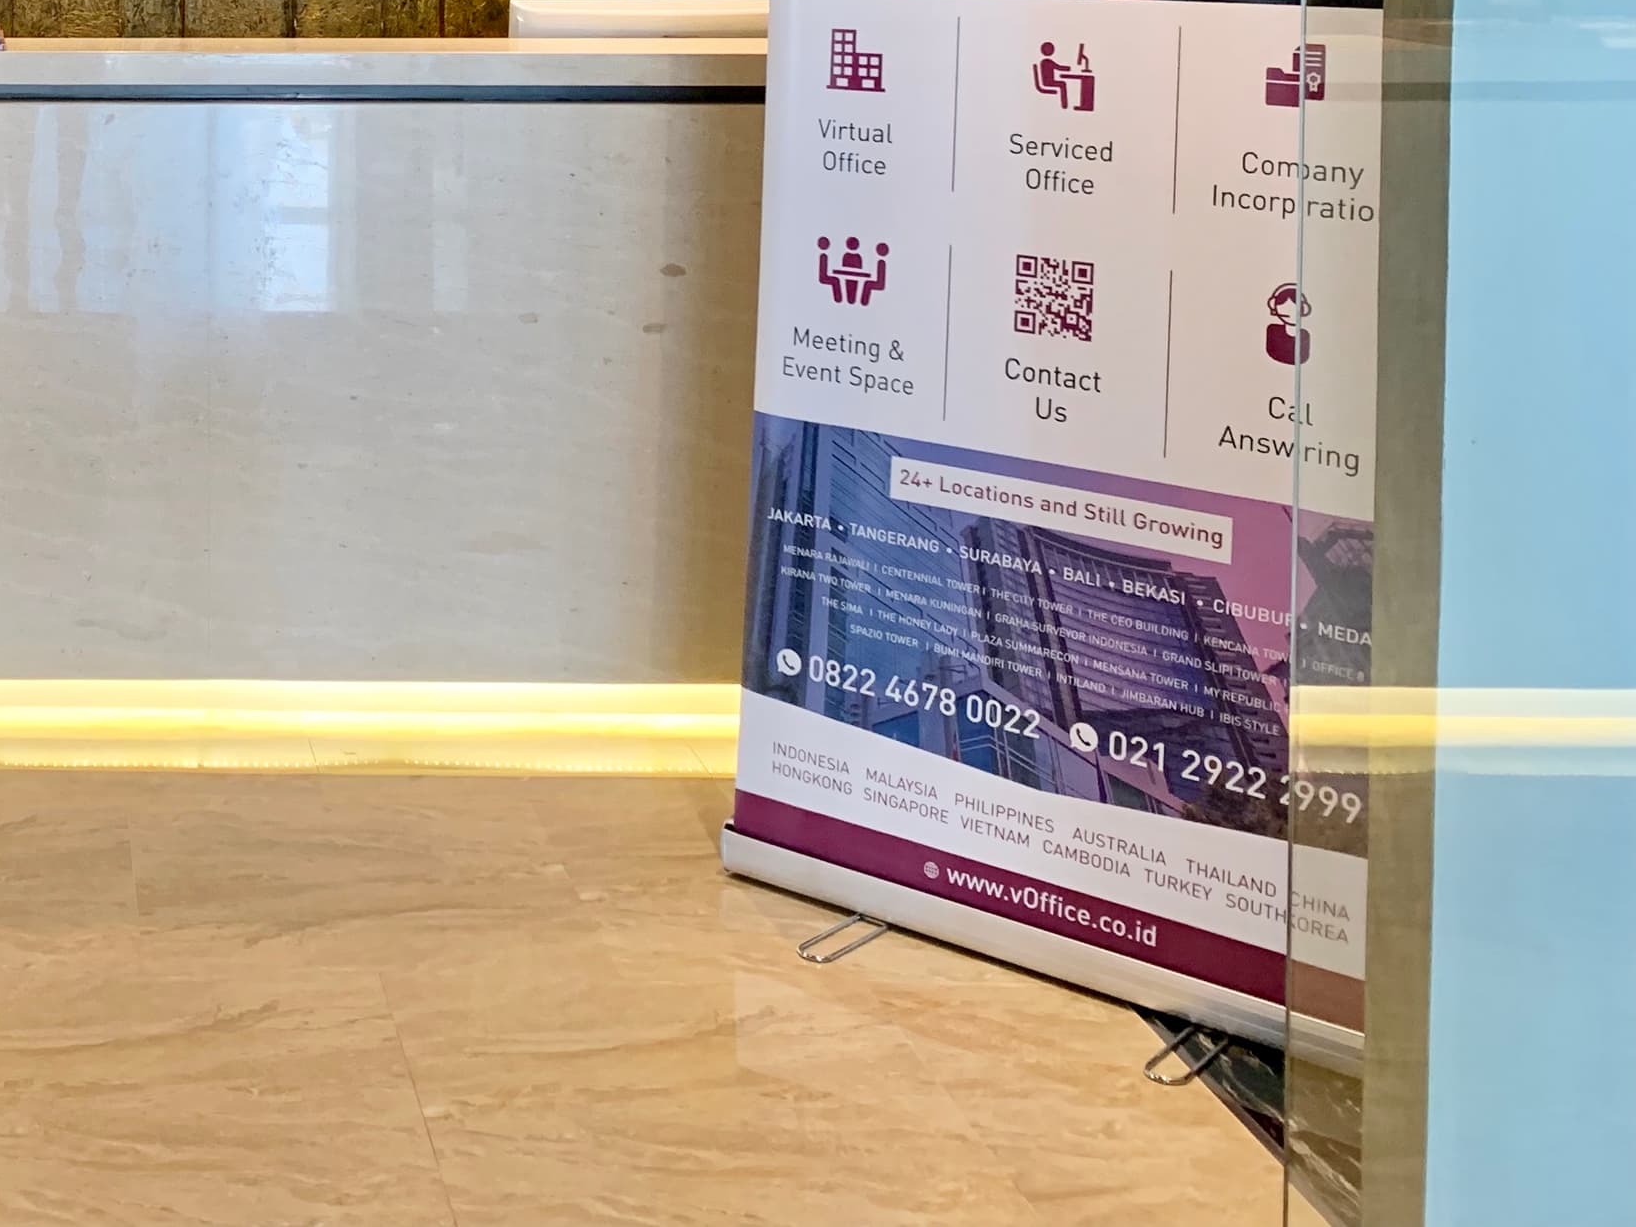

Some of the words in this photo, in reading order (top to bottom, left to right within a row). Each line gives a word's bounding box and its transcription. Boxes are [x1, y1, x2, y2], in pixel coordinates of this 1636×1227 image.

[818, 119, 892, 144] Virtual
[823, 150, 886, 175] Office
[1009, 134, 1113, 162] Serviced
[1025, 168, 1095, 195] Office
[1213, 184, 1374, 222] Incorpratio
[783, 356, 841, 384] Event
[849, 366, 914, 396] Space
[793, 326, 880, 363] Meeting
[888, 339, 904, 361] &
[1005, 357, 1102, 393] Contact
[1035, 396, 1067, 423] Us
[1218, 425, 1359, 477] Answring
[899, 469, 933, 488] 24+
[939, 476, 1034, 509] Locations
[1041, 498, 1077, 517] and
[1084, 503, 1125, 526] Still
[1133, 513, 1224, 549] Growing
[767, 508, 831, 531] JAKARTA
[849, 523, 939, 553] TANGERANG
[959, 545, 1042, 575] SURABAYA
[1064, 567, 1101, 587] BALI
[1122, 579, 1186, 605] BEKASI
[1318, 621, 1372, 646] MEDA
[783, 544, 823, 560] MENARA
[881, 565, 943, 586] CENTENNIAL
[947, 579, 980, 595] TOWER
[991, 588, 1011, 601] THE
[1013, 592, 1035, 608] CITY
[1038, 597, 1073, 615] TOWER
[1088, 610, 1109, 623] THE
[1111, 614, 1133, 628] CEO
[1135, 619, 1189, 641] BUILDING
[1204, 636, 1259, 656] KENCANA
[1262, 648, 1292, 665] TOW
[781, 566, 816, 582] KIRANA
[818, 573, 838, 586] TWO
[840, 577, 871, 594] TOWER
[885, 588, 927, 606] MENARA
[930, 598, 982, 618] KUNINGAN
[995, 613, 1030, 630] GRAHA
[1031, 622, 1086, 643] SURVEYOR
[1088, 634, 1147, 656] INDONESIA
[1162, 651, 1202, 670] GRAND
[1204, 661, 1234, 677] SLIPI
[1236, 669, 1276, 686] TOWER
[822, 597, 839, 609] THE
[840, 600, 863, 615] SIMA
[878, 610, 896, 623] THE
[898, 614, 932, 631] HONEY
[934, 621, 958, 636] LADY
[971, 631, 1003, 648] PLAZA
[1005, 639, 1079, 664] SUMMARECON
[1093, 660, 1146, 680] MENSANA
[1149, 673, 1188, 691] TOWER
[1204, 685, 1221, 699] MY
[1222, 690, 1281, 713] REPUBLIC
[809, 655, 876, 697] 0822
[885, 674, 956, 717] 4678
[966, 694, 1041, 739] 0022
[850, 624, 882, 640] SPAZIO
[885, 632, 918, 648] TOWER
[934, 644, 959, 659] BUMI
[961, 652, 1004, 669] MANDIRI
[1007, 661, 1042, 678] TOWER
[1056, 672, 1106, 693] INTILAND
[1121, 689, 1177, 710] JIMBARAN
[1180, 703, 1204, 717] HUB
[1220, 713, 1242, 727] IBIS
[1244, 719, 1280, 736] STYLE
[1109, 730, 1165, 772] 021
[1181, 749, 1266, 799] 2922
[771, 760, 853, 796] HONGKONG
[863, 787, 949, 824] SINGAPORE
[960, 814, 1030, 848] VIETNAM
[1042, 840, 1131, 878] CAMBODIA
[1144, 868, 1213, 901] TURKEY
[1226, 893, 1286, 921] SOUTH
[772, 742, 850, 775] INDONESIA
[865, 768, 938, 800] MALAYSIA
[955, 792, 1055, 833] PHILIPPINES
[1072, 828, 1166, 866] AUSTRALIA
[1186, 858, 1277, 898] THAILAND
[1291, 891, 1350, 922] CHINA
[945, 865, 1158, 948] www.vOffice.co.id
